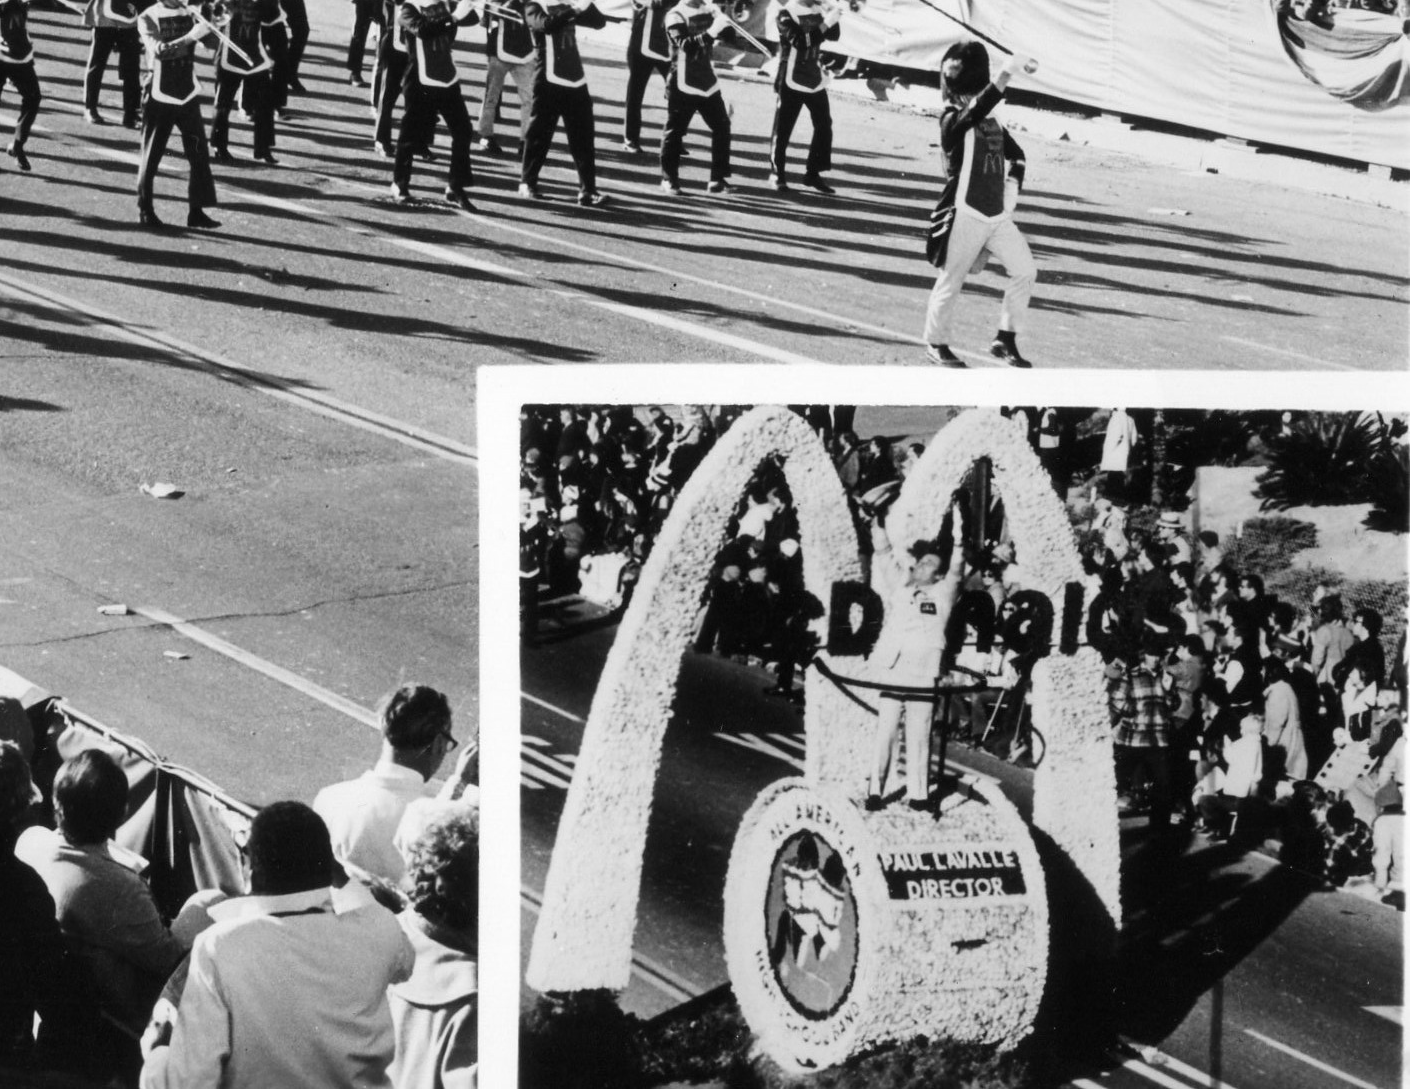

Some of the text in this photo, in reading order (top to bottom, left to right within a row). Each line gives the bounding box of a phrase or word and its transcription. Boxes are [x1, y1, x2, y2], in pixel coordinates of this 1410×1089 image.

[880, 851, 1017, 872] PAUL LAVALLE
[906, 877, 1006, 899] DIRECTOR
